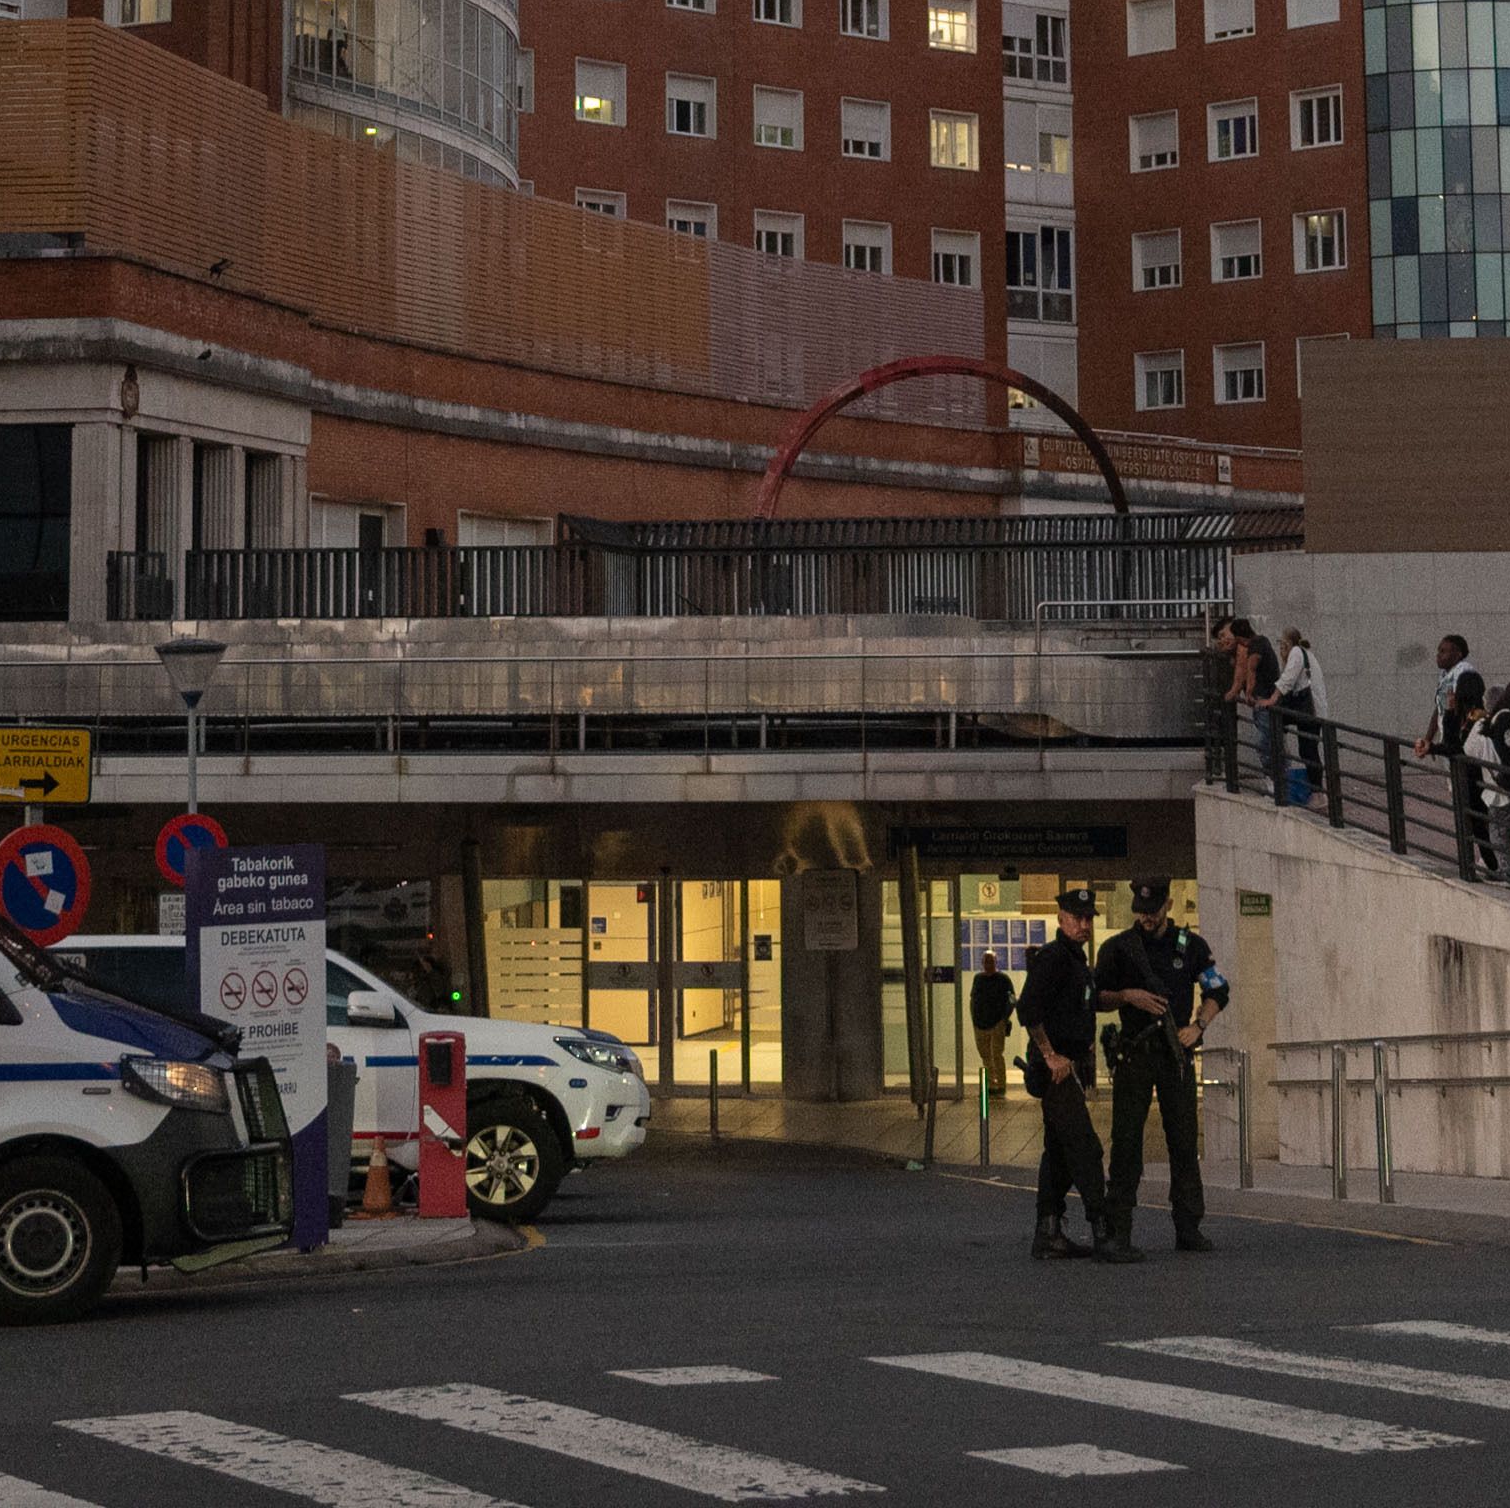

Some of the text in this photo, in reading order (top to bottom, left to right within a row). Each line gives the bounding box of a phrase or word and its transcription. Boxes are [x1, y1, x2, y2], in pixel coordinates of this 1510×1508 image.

[1, 734, 81, 747] URGENCIAS
[231, 855, 295, 872] Tabakorik
[217, 873, 309, 893] gabeko gunea
[212, 896, 314, 916] Área sin tabaco
[220, 926, 306, 946] DEBEKATUTA
